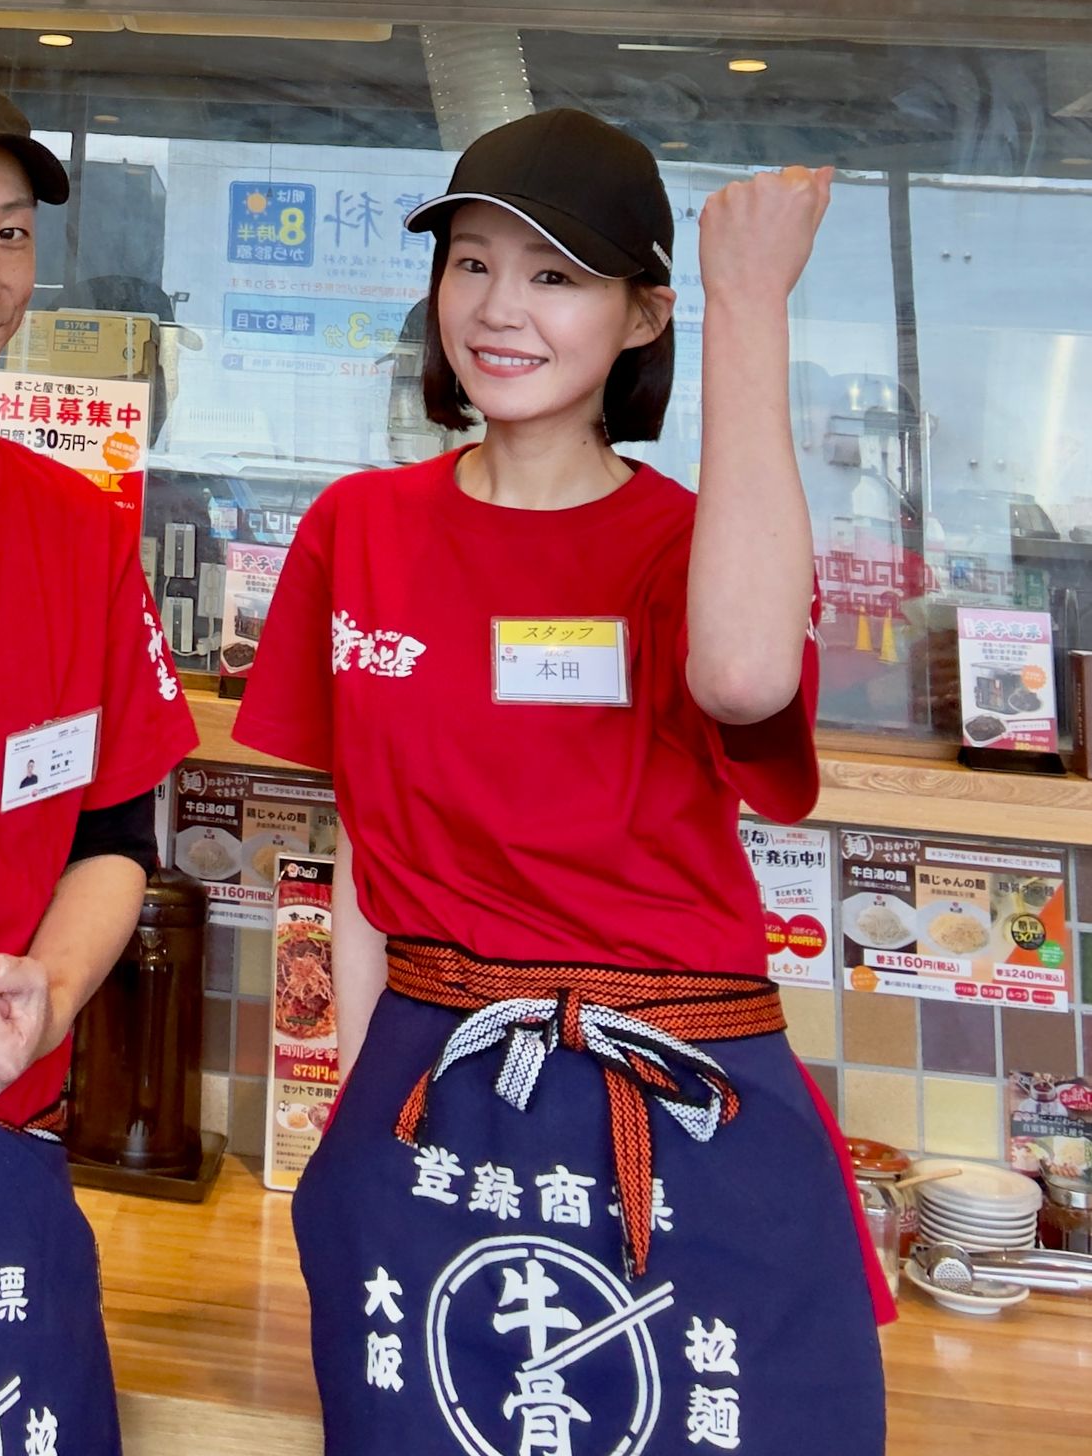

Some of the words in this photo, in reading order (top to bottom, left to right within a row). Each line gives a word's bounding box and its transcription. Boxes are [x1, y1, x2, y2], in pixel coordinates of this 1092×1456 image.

[15, 381, 98, 396] まこと屋で働こう!
[522, 625, 594, 642] スタッフ
[974, 621, 1043, 640] 辛子高菜
[536, 659, 580, 681] 本田
[181, 771, 202, 793] 麺
[186, 801, 236, 816] 牛白湯の麺
[844, 834, 869, 860] 麺
[851, 866, 907, 883] 牛白湯の麺
[919, 873, 986, 890] 鶏じゃんの麺
[876, 954, 960, 973] 替玉160円(税込)
[996, 969, 1063, 983] 替玉240円(税込)
[364, 1266, 404, 1393] 大阪
[493, 1260, 592, 1456] 牛骨
[684, 1316, 741, 1450] 拉麺
